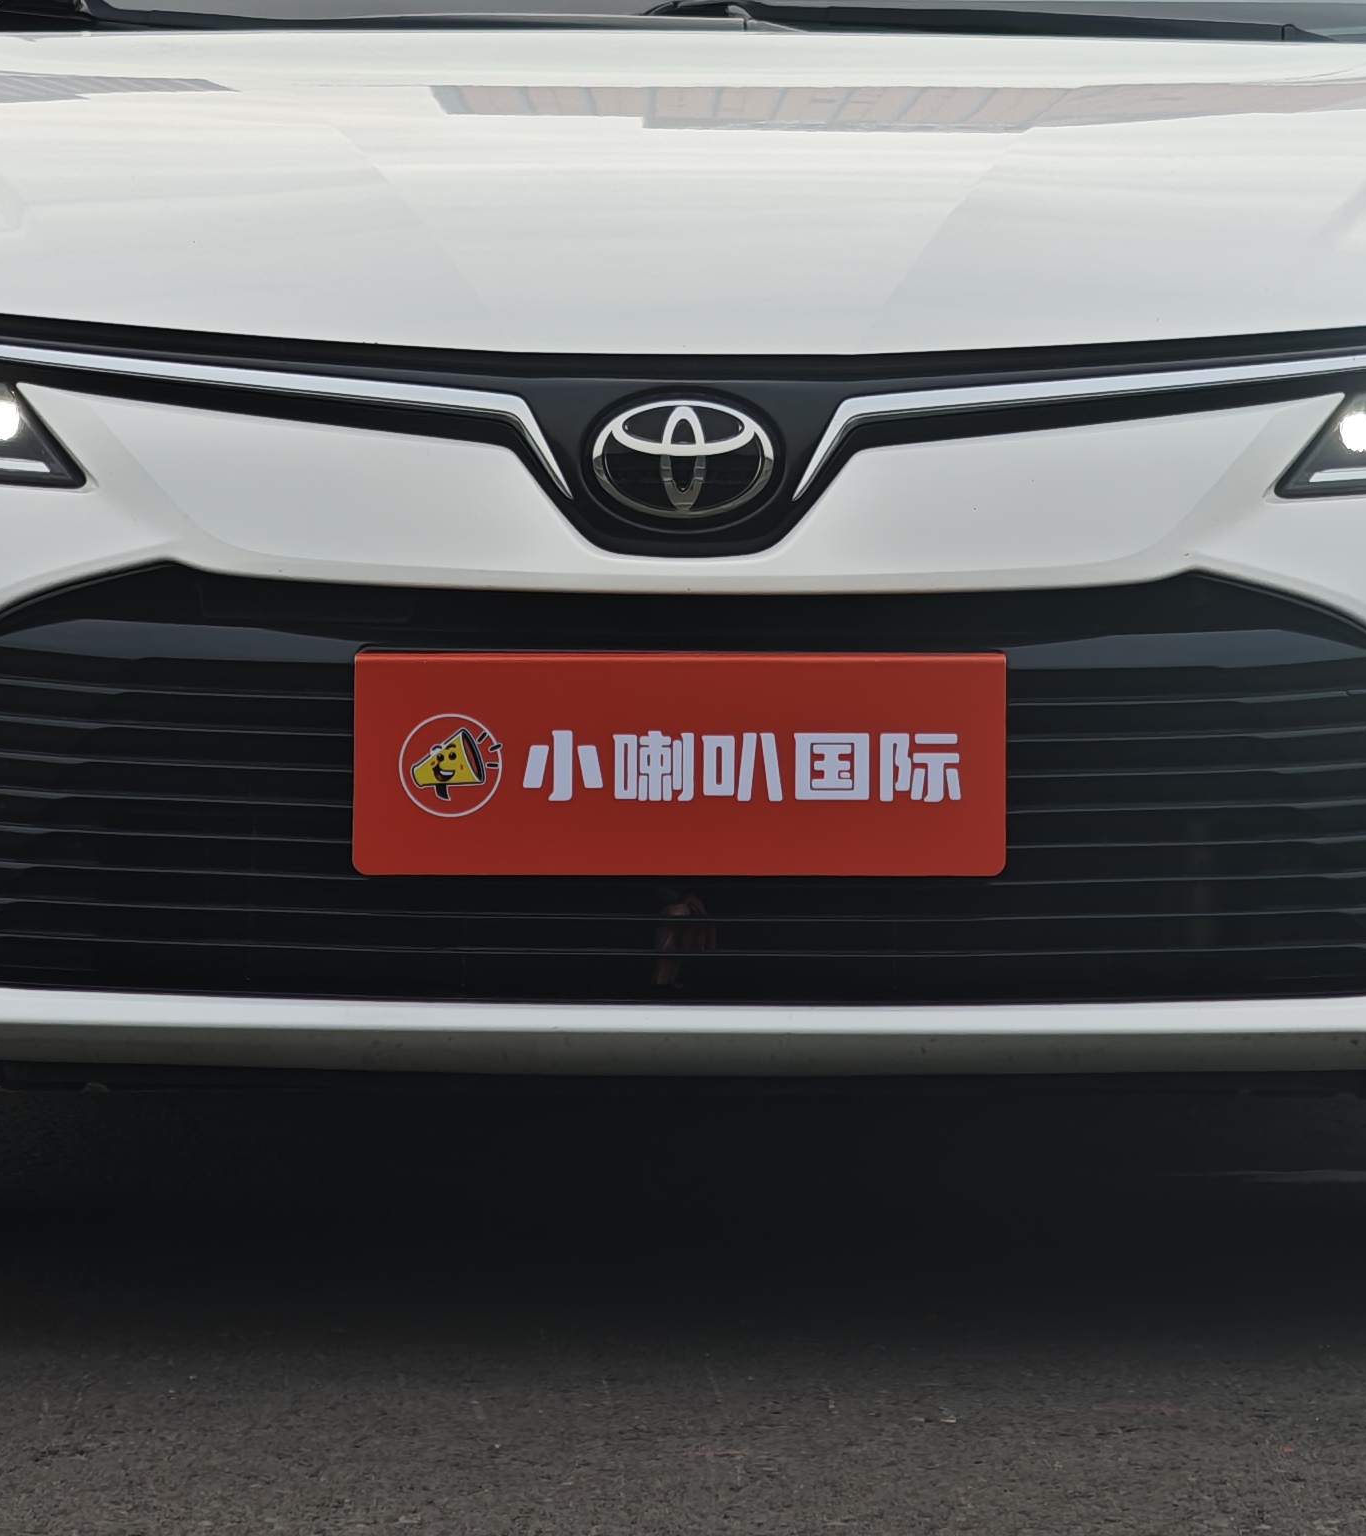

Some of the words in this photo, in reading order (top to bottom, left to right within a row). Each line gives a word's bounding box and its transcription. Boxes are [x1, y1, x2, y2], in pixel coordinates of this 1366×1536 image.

[523, 730, 962, 802] 小喇叭国际
